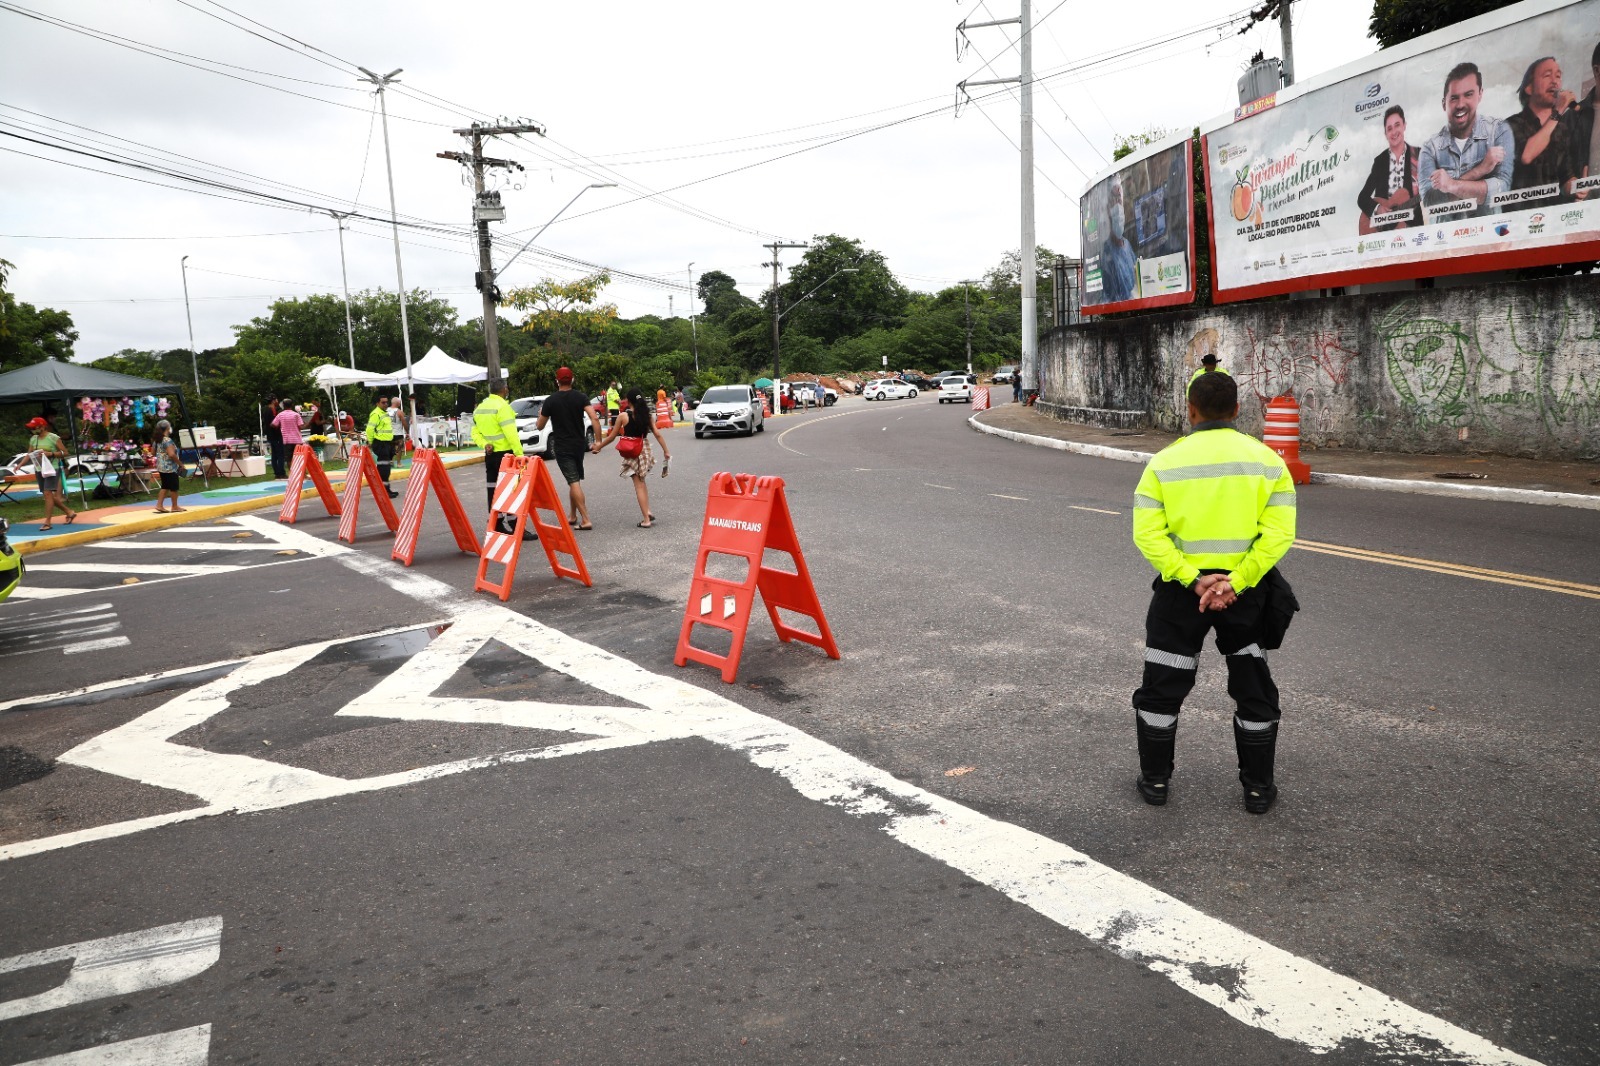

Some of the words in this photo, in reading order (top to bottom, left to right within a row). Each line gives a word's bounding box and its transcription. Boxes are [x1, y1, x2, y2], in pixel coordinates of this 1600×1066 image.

[1355, 96, 1389, 113] Eurosono
[1260, 152, 1341, 208] Piscicultura
[1576, 178, 1600, 190] ISAIA
[1494, 192, 1519, 203] DAVID
[1521, 187, 1557, 199] QUINLAN
[1429, 206, 1448, 215] XAND
[1448, 202, 1472, 212] AVIÃO
[1237, 226, 1246, 236] DIA
[1271, 218, 1279, 227] DE
[1280, 212, 1310, 225] OUTUBRO
[1310, 209, 1320, 218] DE
[1321, 205, 1336, 217] 2021
[1374, 215, 1386, 223] TOM
[1388, 211, 1410, 221] CLEBER
[1248, 231, 1266, 242] LOCAL:
[1266, 228, 1276, 238] RIO
[1276, 225, 1296, 236] PRETO
[708, 517, 762, 533] MANAUSTRANS
